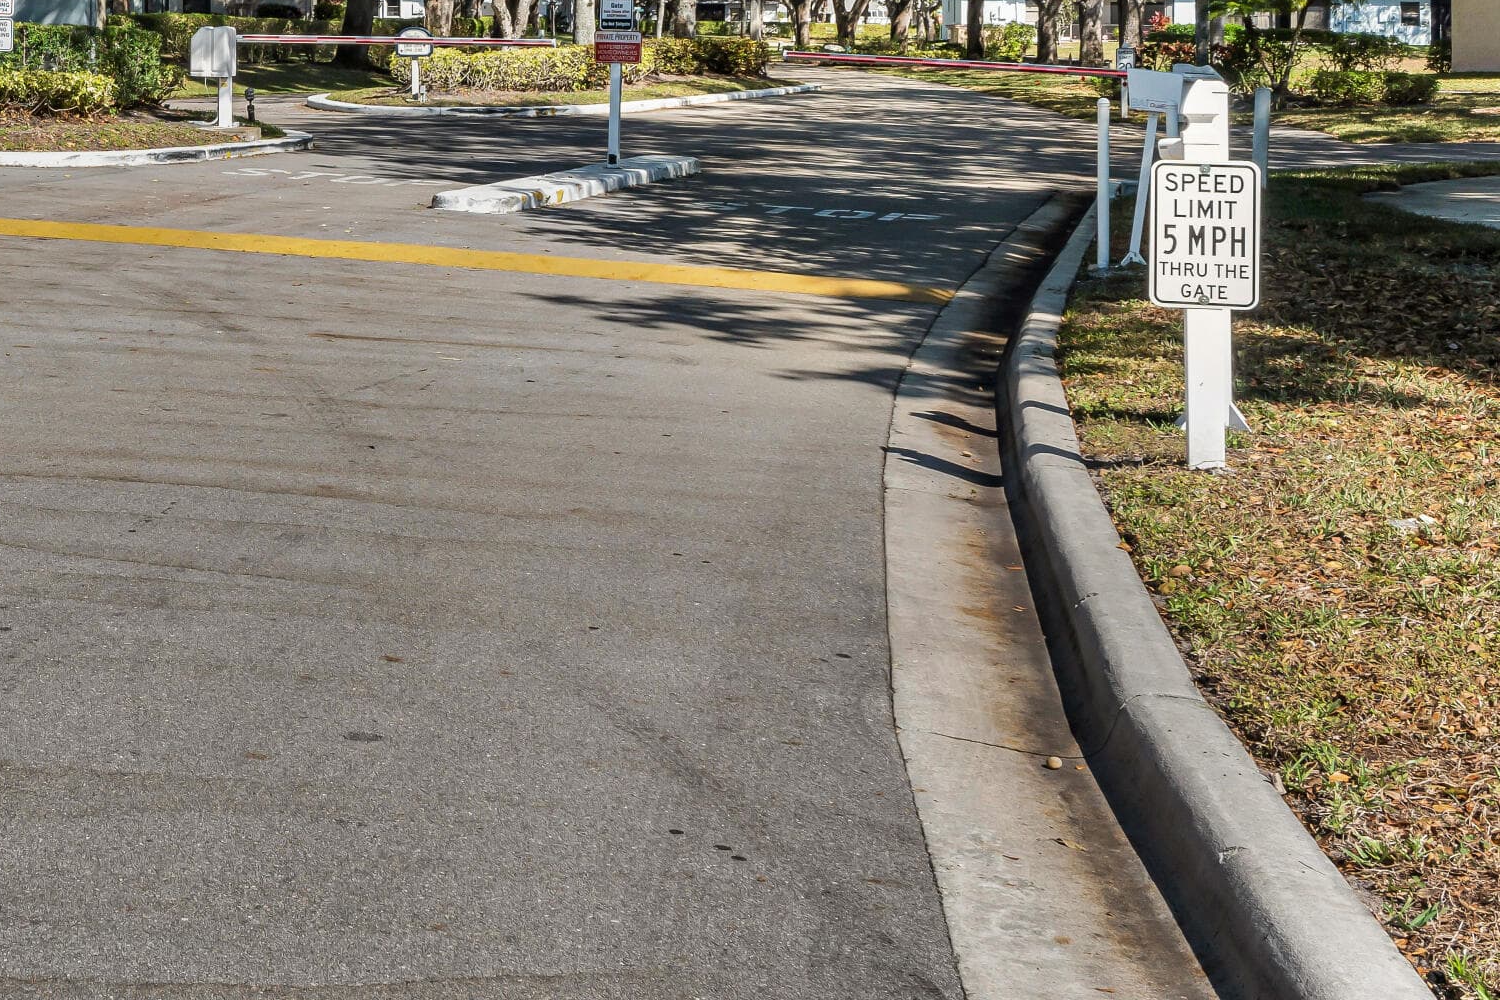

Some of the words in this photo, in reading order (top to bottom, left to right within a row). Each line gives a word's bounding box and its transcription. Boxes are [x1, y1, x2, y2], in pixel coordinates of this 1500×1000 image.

[1165, 172, 1244, 194] SPEED
[1173, 198, 1237, 220] LIMIT
[1163, 224, 1177, 255] 5
[1188, 225, 1246, 257] MPH
[1158, 261, 1208, 277] THRU
[1214, 263, 1250, 280] THE
[1180, 283, 1228, 300] GATE
